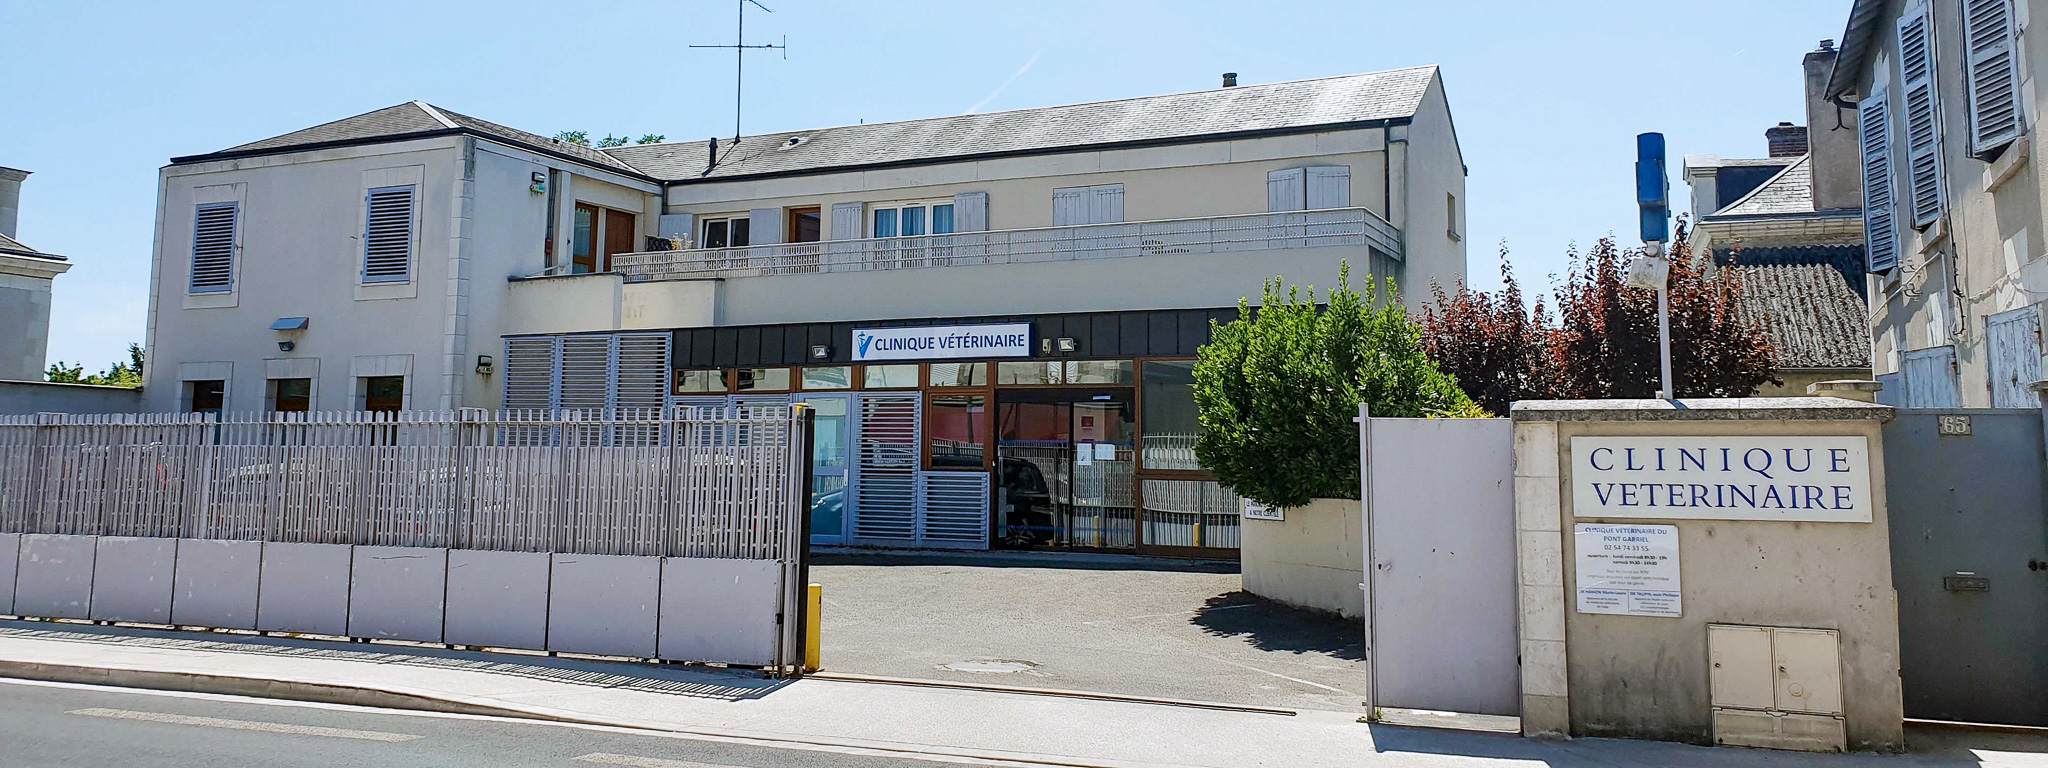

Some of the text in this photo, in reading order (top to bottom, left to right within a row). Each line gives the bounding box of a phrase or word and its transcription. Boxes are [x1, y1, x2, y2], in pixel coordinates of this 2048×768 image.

[875, 332, 1025, 351] CLINIQUE VÉTÉRINAIRE
[1944, 416, 1966, 433] 65
[1590, 447, 1850, 479] CLINIQUE
[1591, 482, 1854, 510] VETERINAIRE
